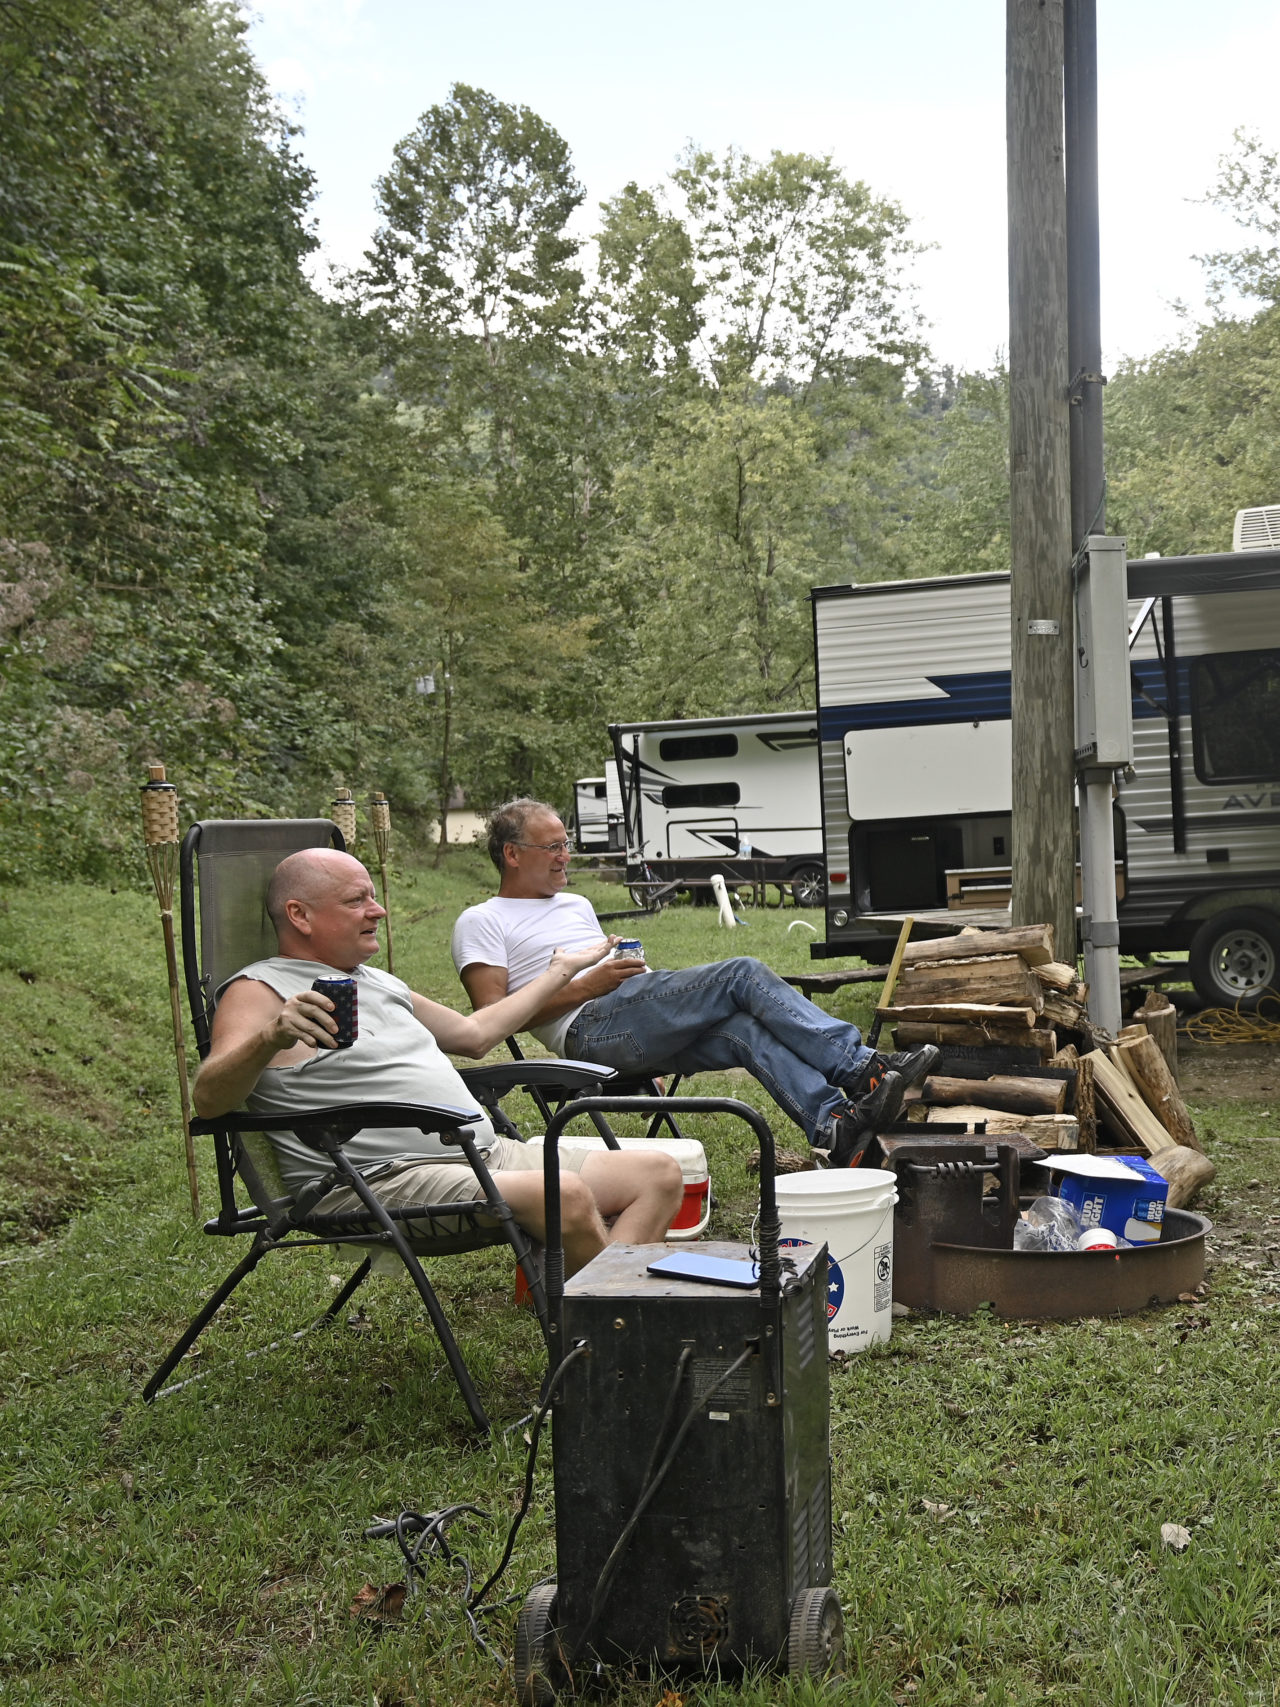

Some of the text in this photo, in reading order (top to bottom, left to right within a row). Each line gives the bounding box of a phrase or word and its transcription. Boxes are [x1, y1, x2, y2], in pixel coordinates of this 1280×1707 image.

[1080, 1200, 1094, 1226] BUD
[1147, 1201, 1157, 1220] BUD
[1153, 1200, 1165, 1223] LIGHT
[833, 1331, 860, 1339] Everything
